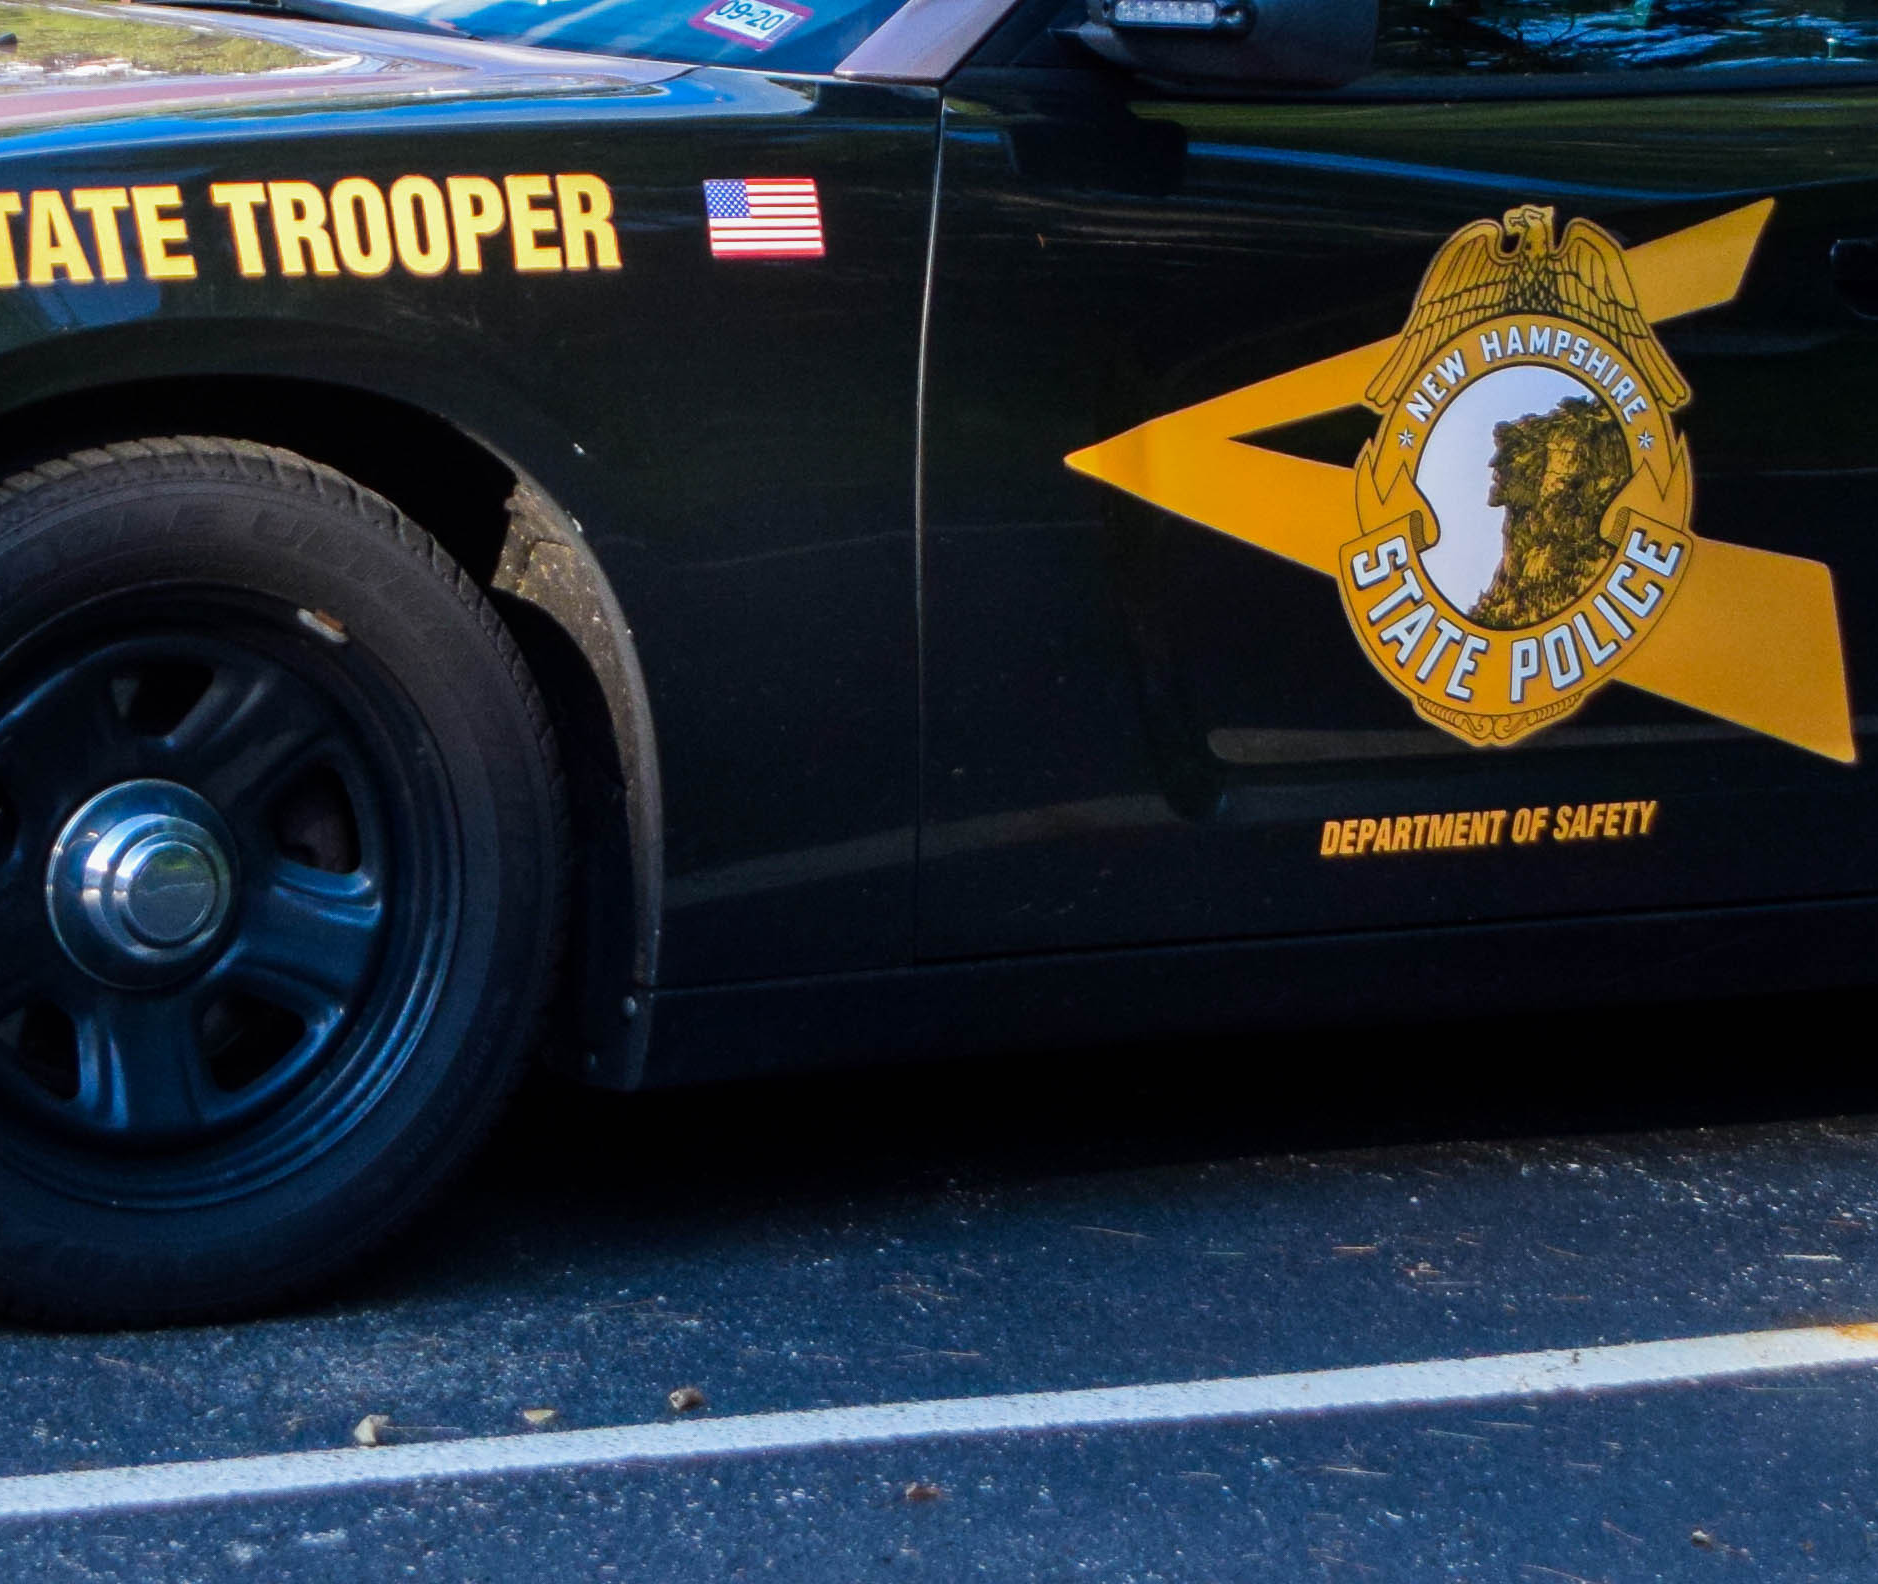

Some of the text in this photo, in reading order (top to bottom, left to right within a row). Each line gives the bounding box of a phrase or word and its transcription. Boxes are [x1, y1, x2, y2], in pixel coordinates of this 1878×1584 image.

[715, 0, 785, 31] 09-20
[209, 173, 623, 279] TROOPER
[1404, 324, 1650, 424] NEW HAMPSHIRE
[1351, 528, 1684, 704] STATE POLICE
[1320, 800, 1658, 856] DEPARTMENT OF SAFETY
